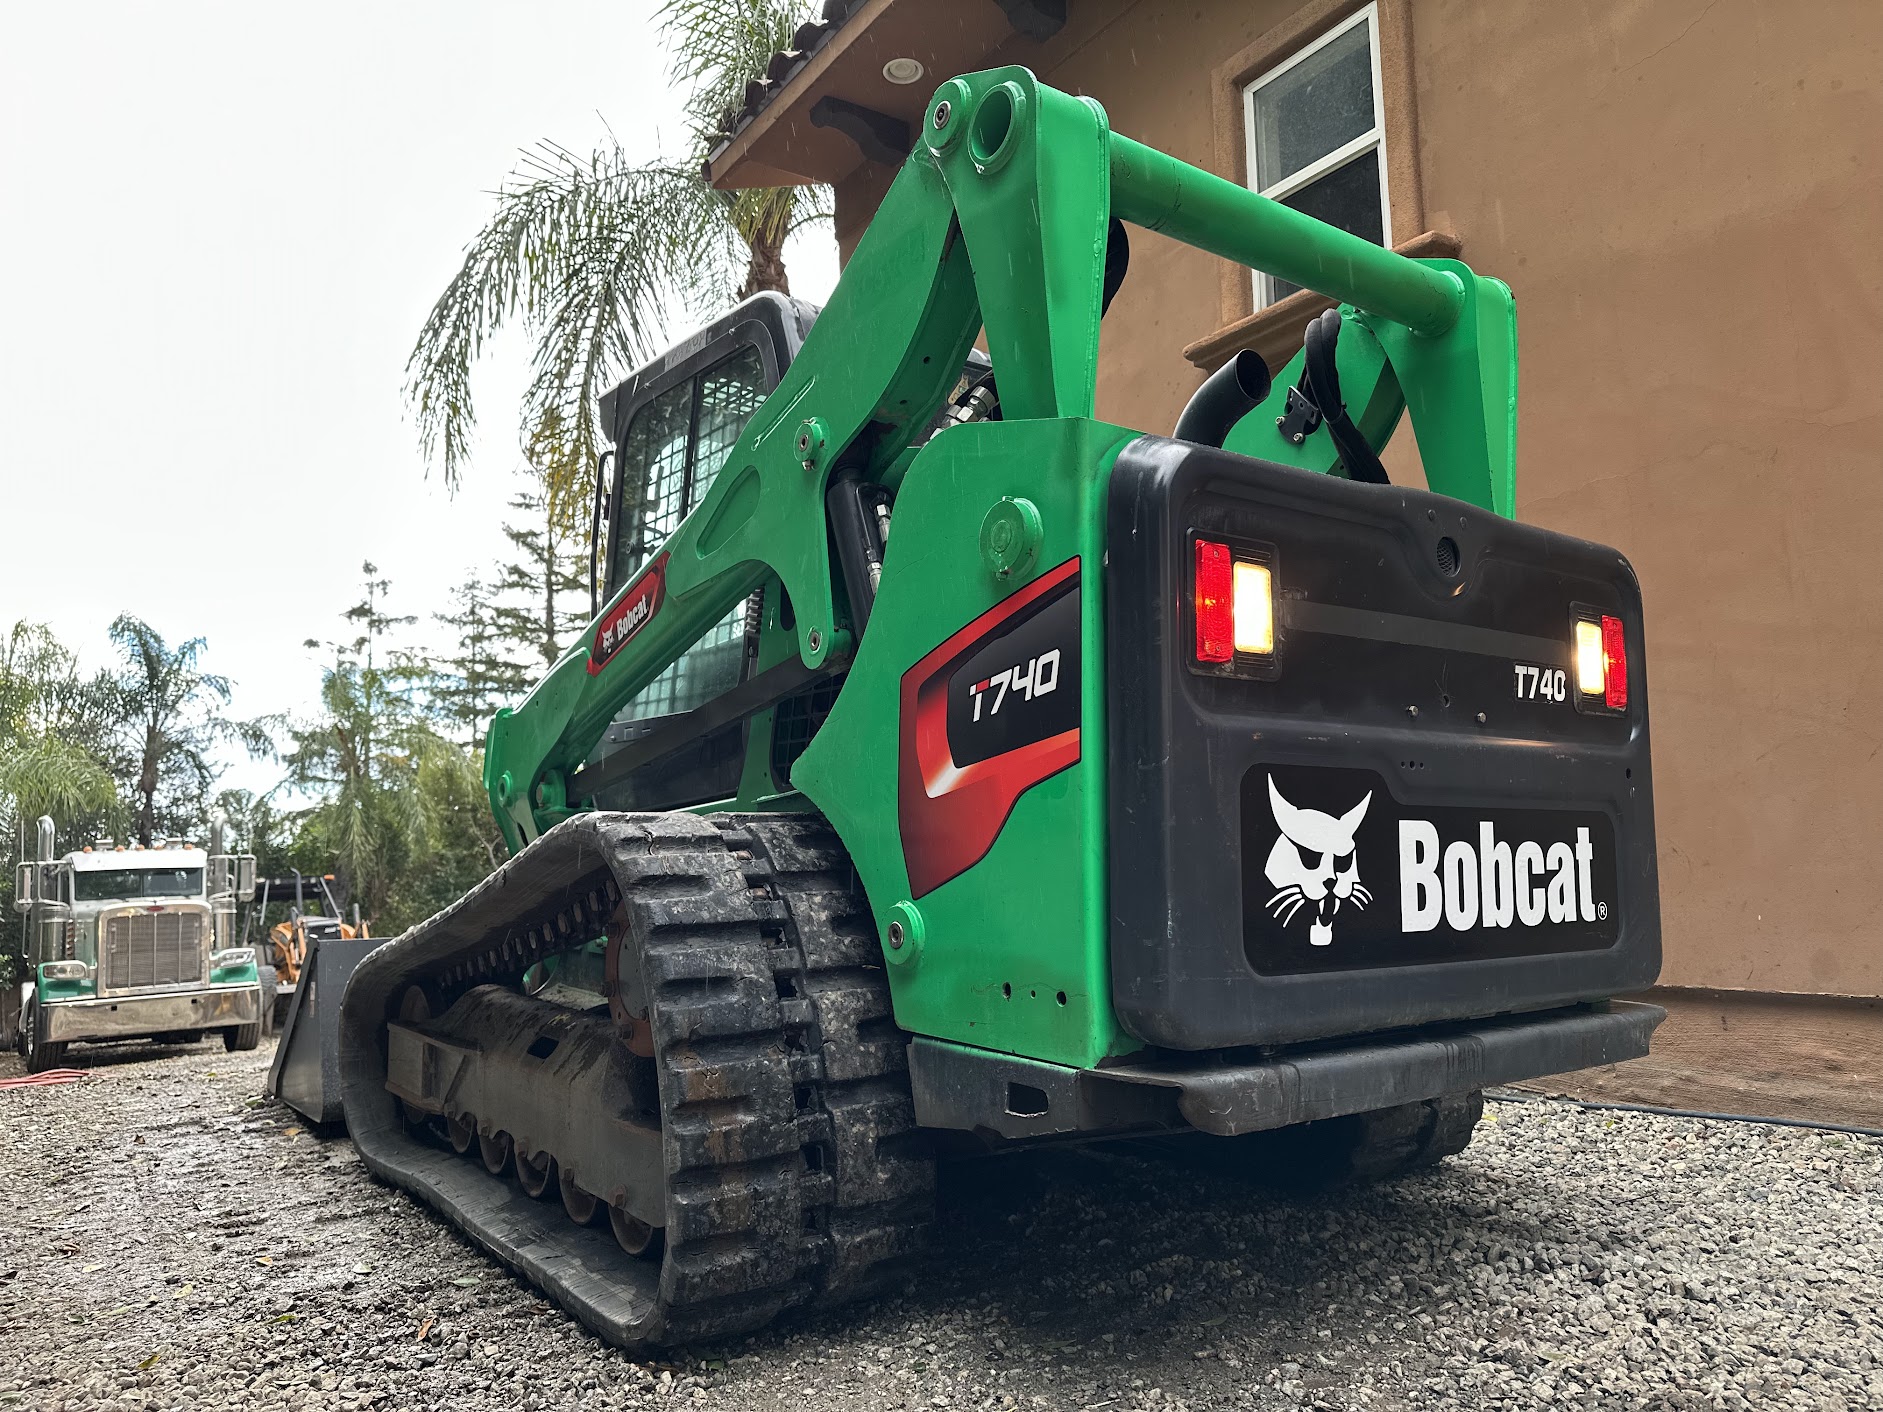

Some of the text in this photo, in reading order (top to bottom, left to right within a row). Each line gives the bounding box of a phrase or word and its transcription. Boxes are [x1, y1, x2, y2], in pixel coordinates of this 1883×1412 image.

[617, 594, 648, 641] Bobcat
[969, 649, 1061, 723] T740
[1514, 664, 1566, 702] T740
